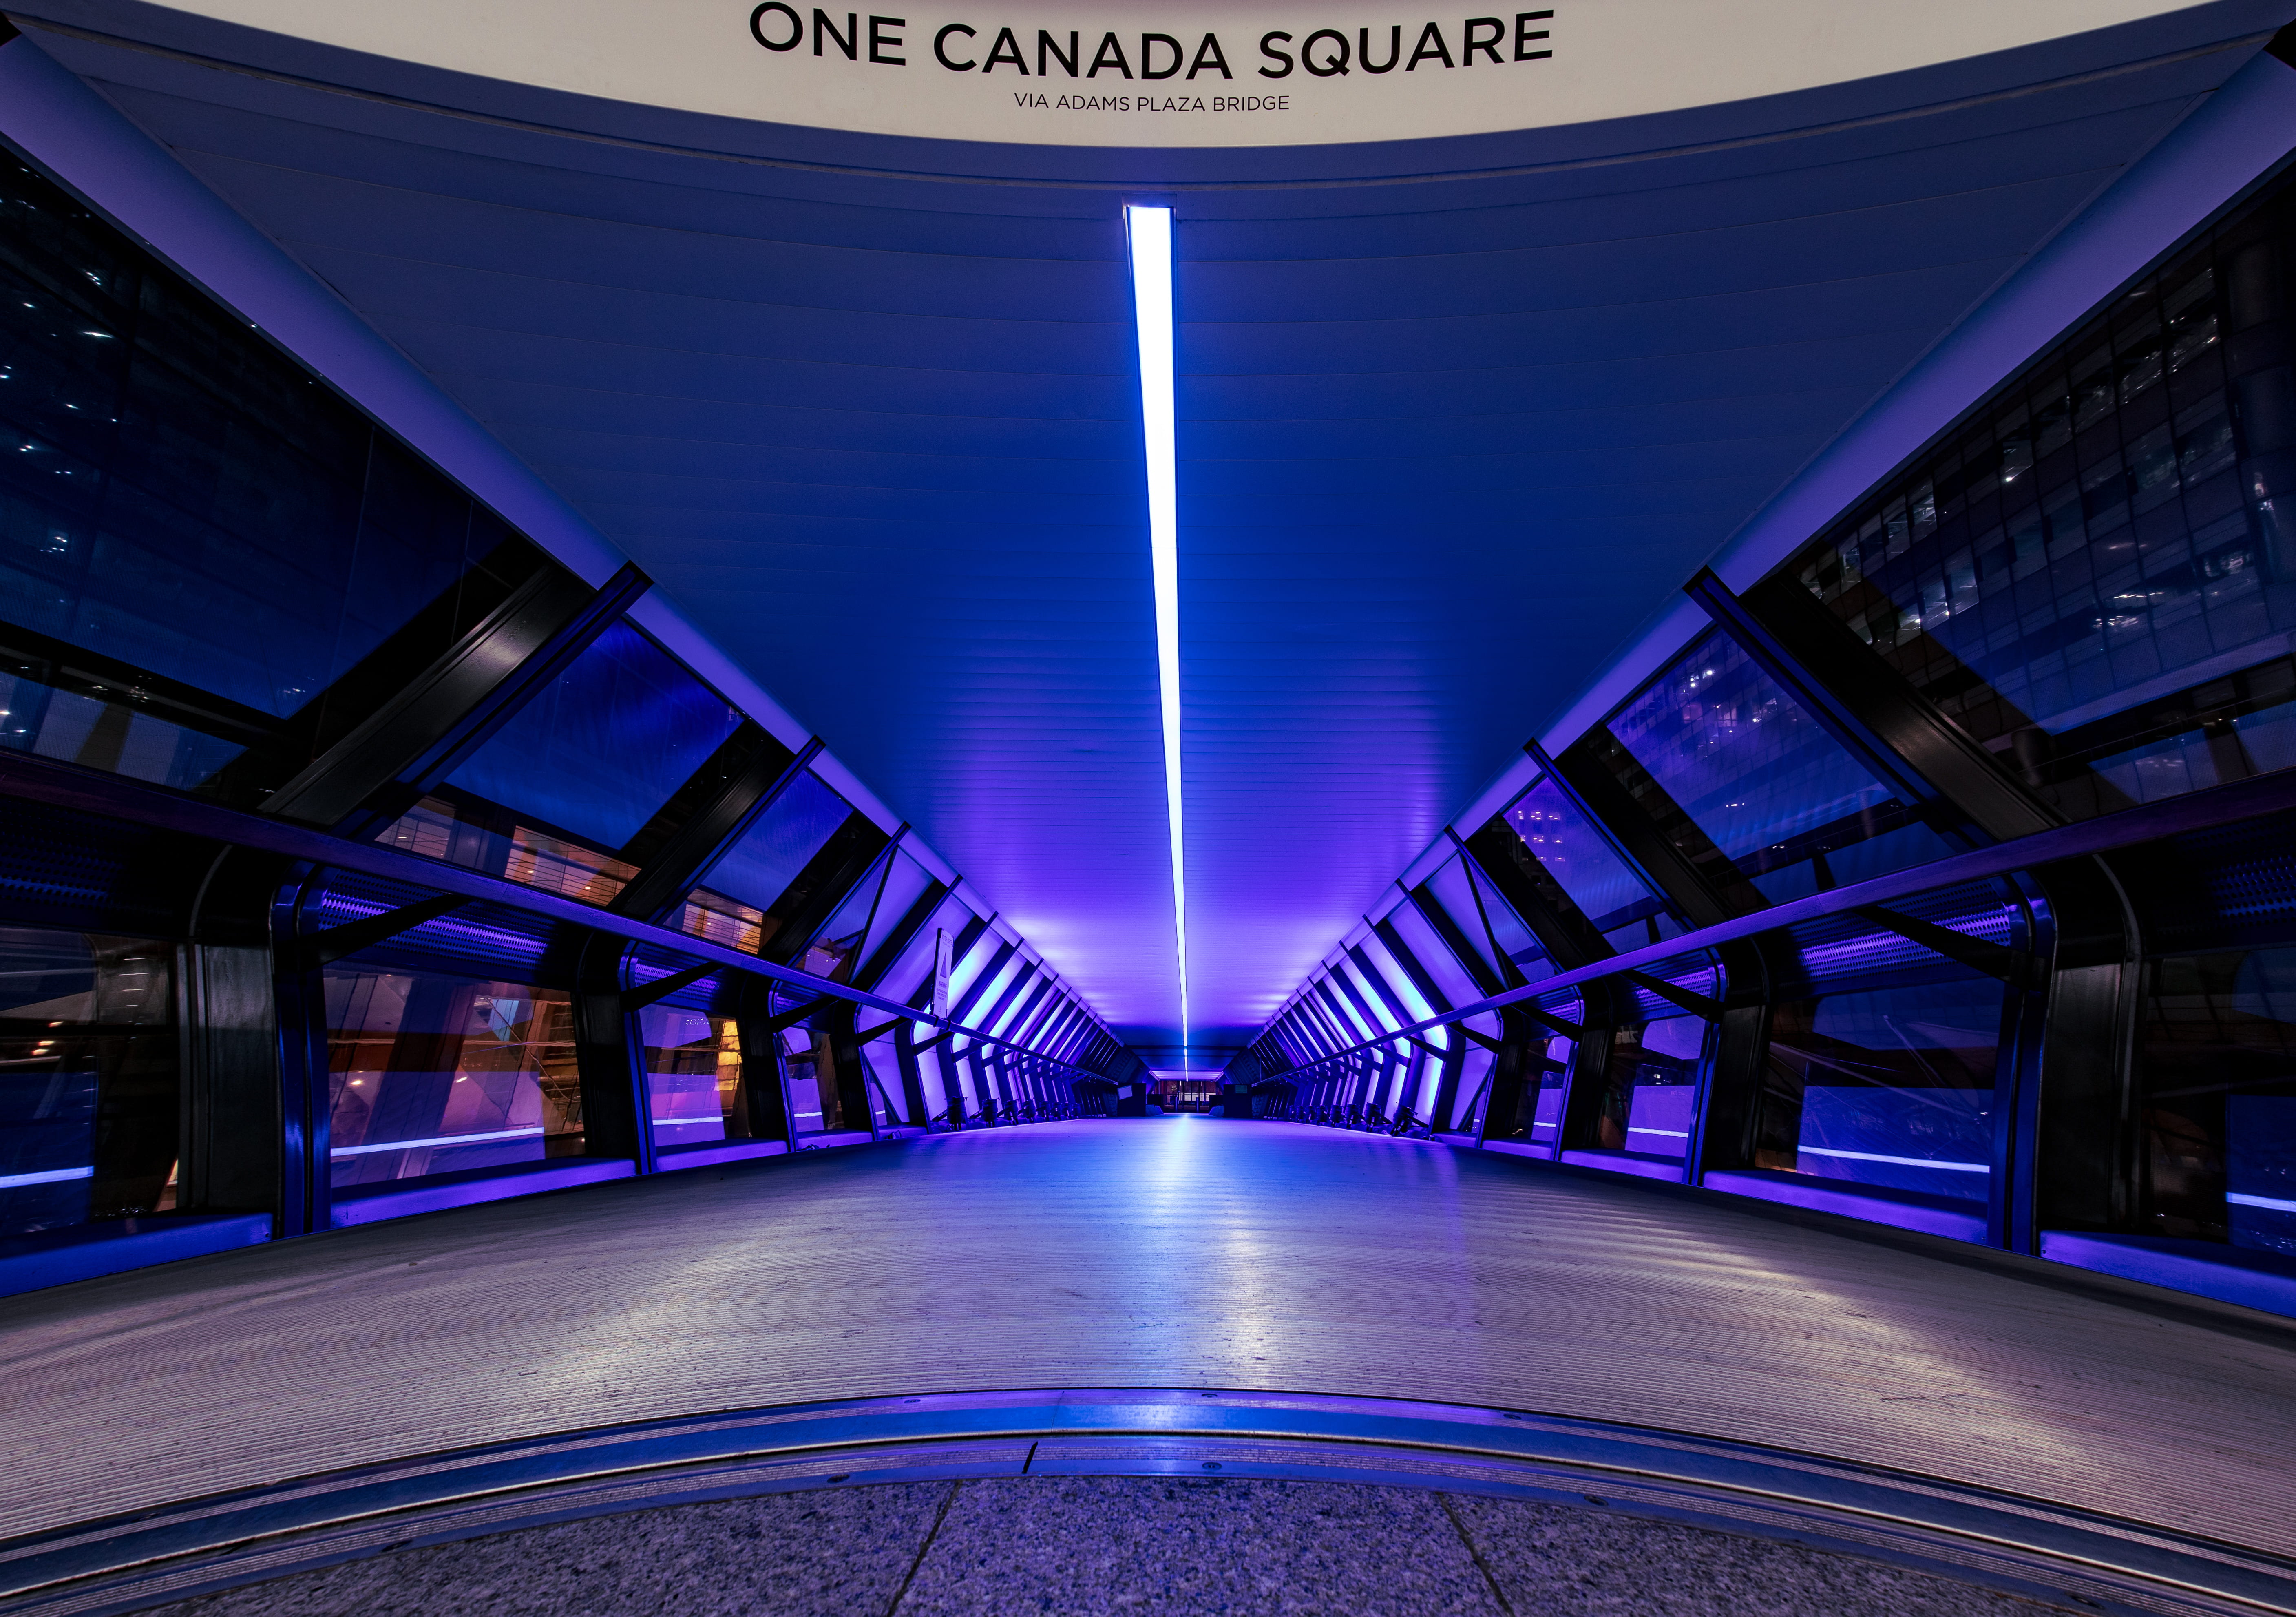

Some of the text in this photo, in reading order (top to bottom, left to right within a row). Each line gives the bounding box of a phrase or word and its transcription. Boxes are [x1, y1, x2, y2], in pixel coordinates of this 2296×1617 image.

[749, 1, 1554, 80] ONE CANADA SQUARE
[1014, 93, 1289, 111] VIA ADAMS PLAZA BRIDGE
